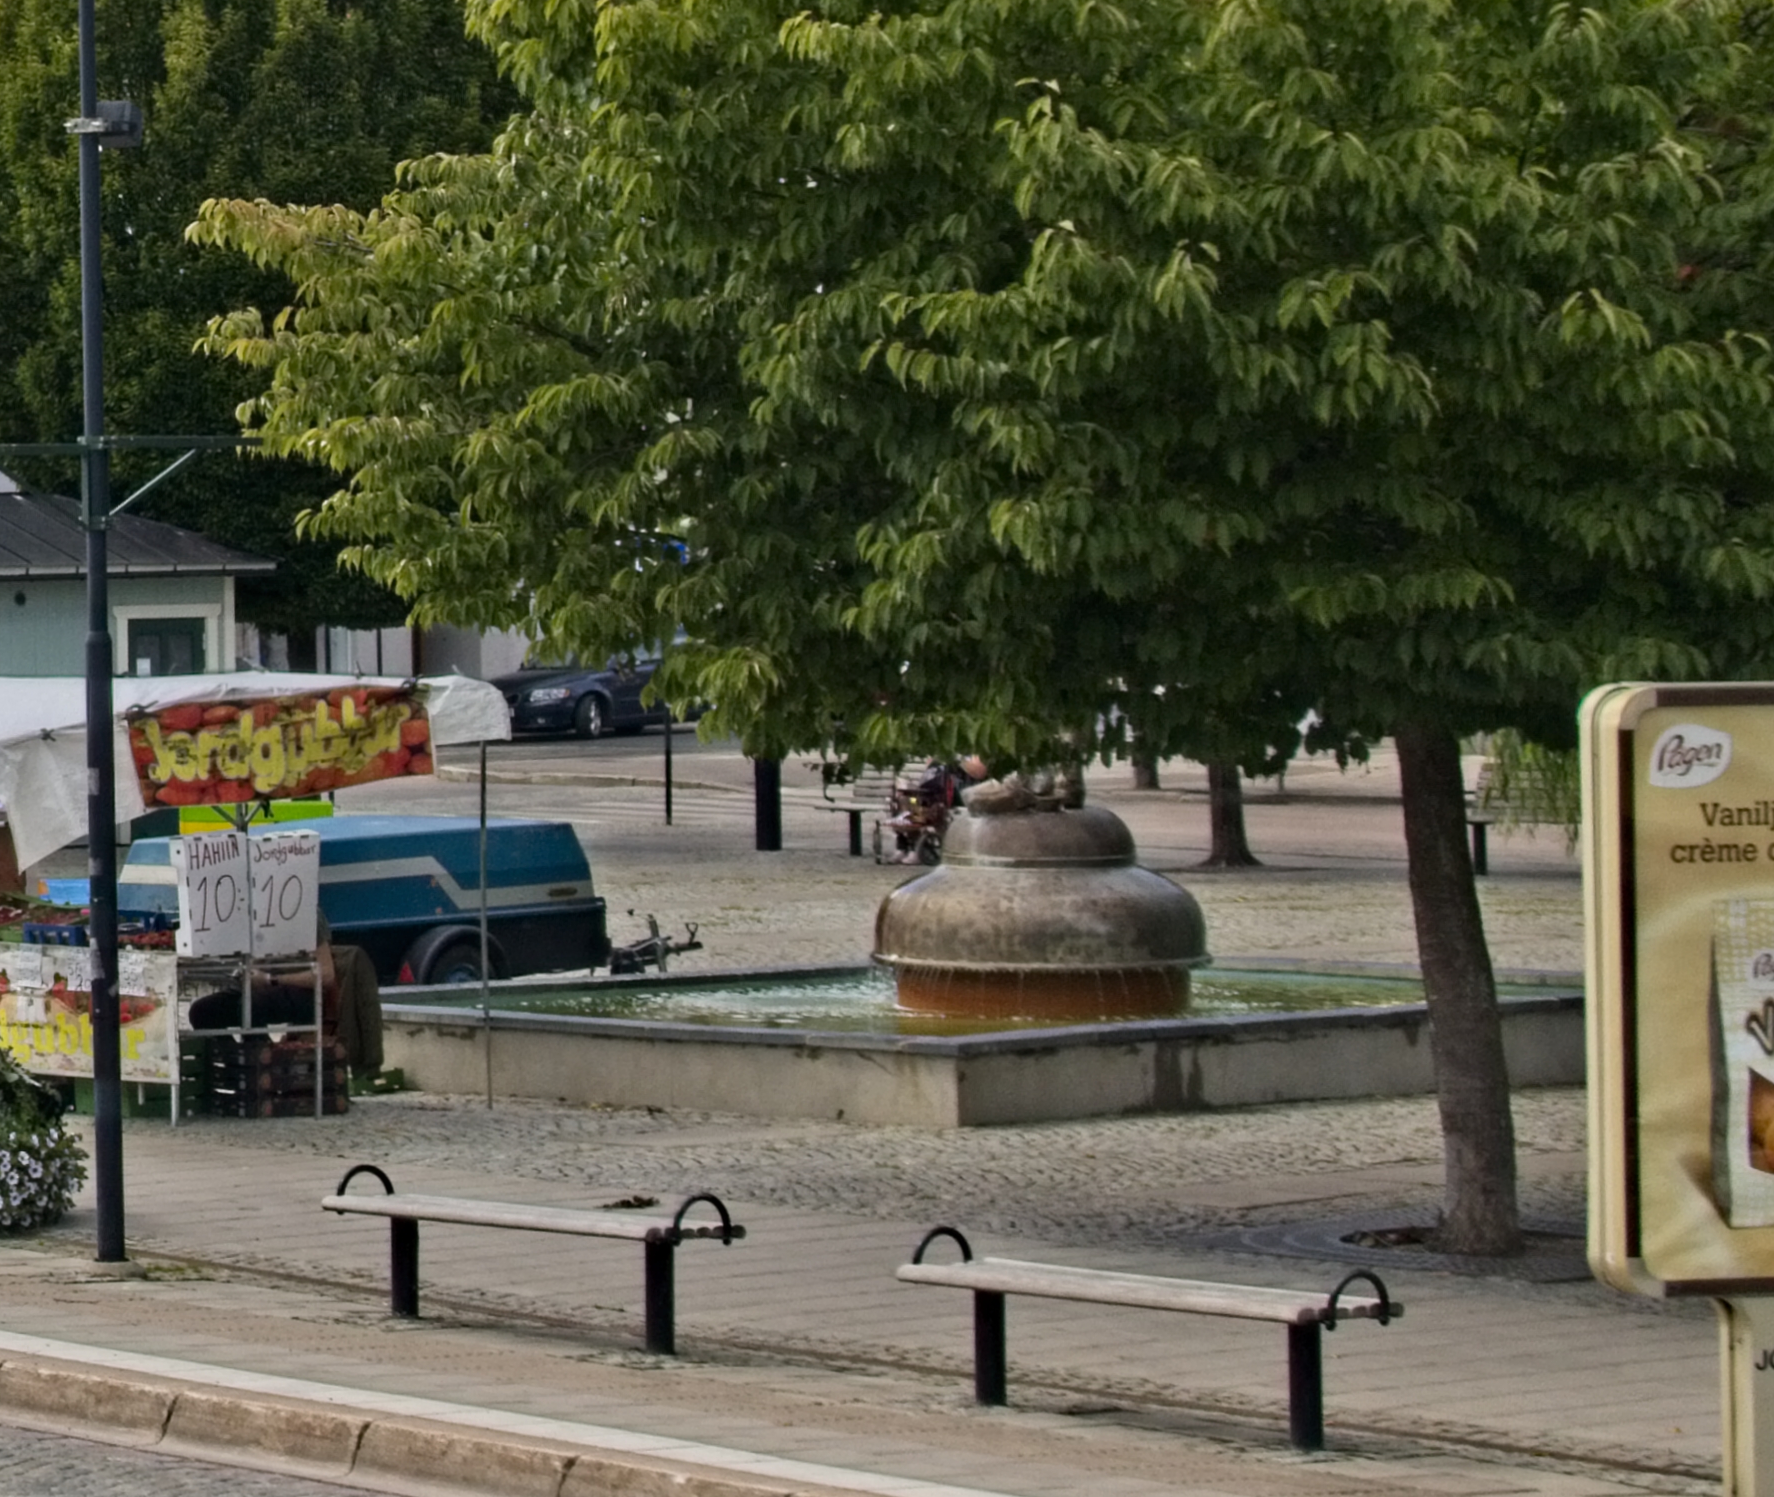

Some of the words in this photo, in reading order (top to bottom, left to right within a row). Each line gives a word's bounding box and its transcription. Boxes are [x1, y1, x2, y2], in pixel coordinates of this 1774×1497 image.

[1699, 800, 1774, 832] Vanil
[1669, 837, 1758, 864] crème
[259, 874, 303, 928] 10
